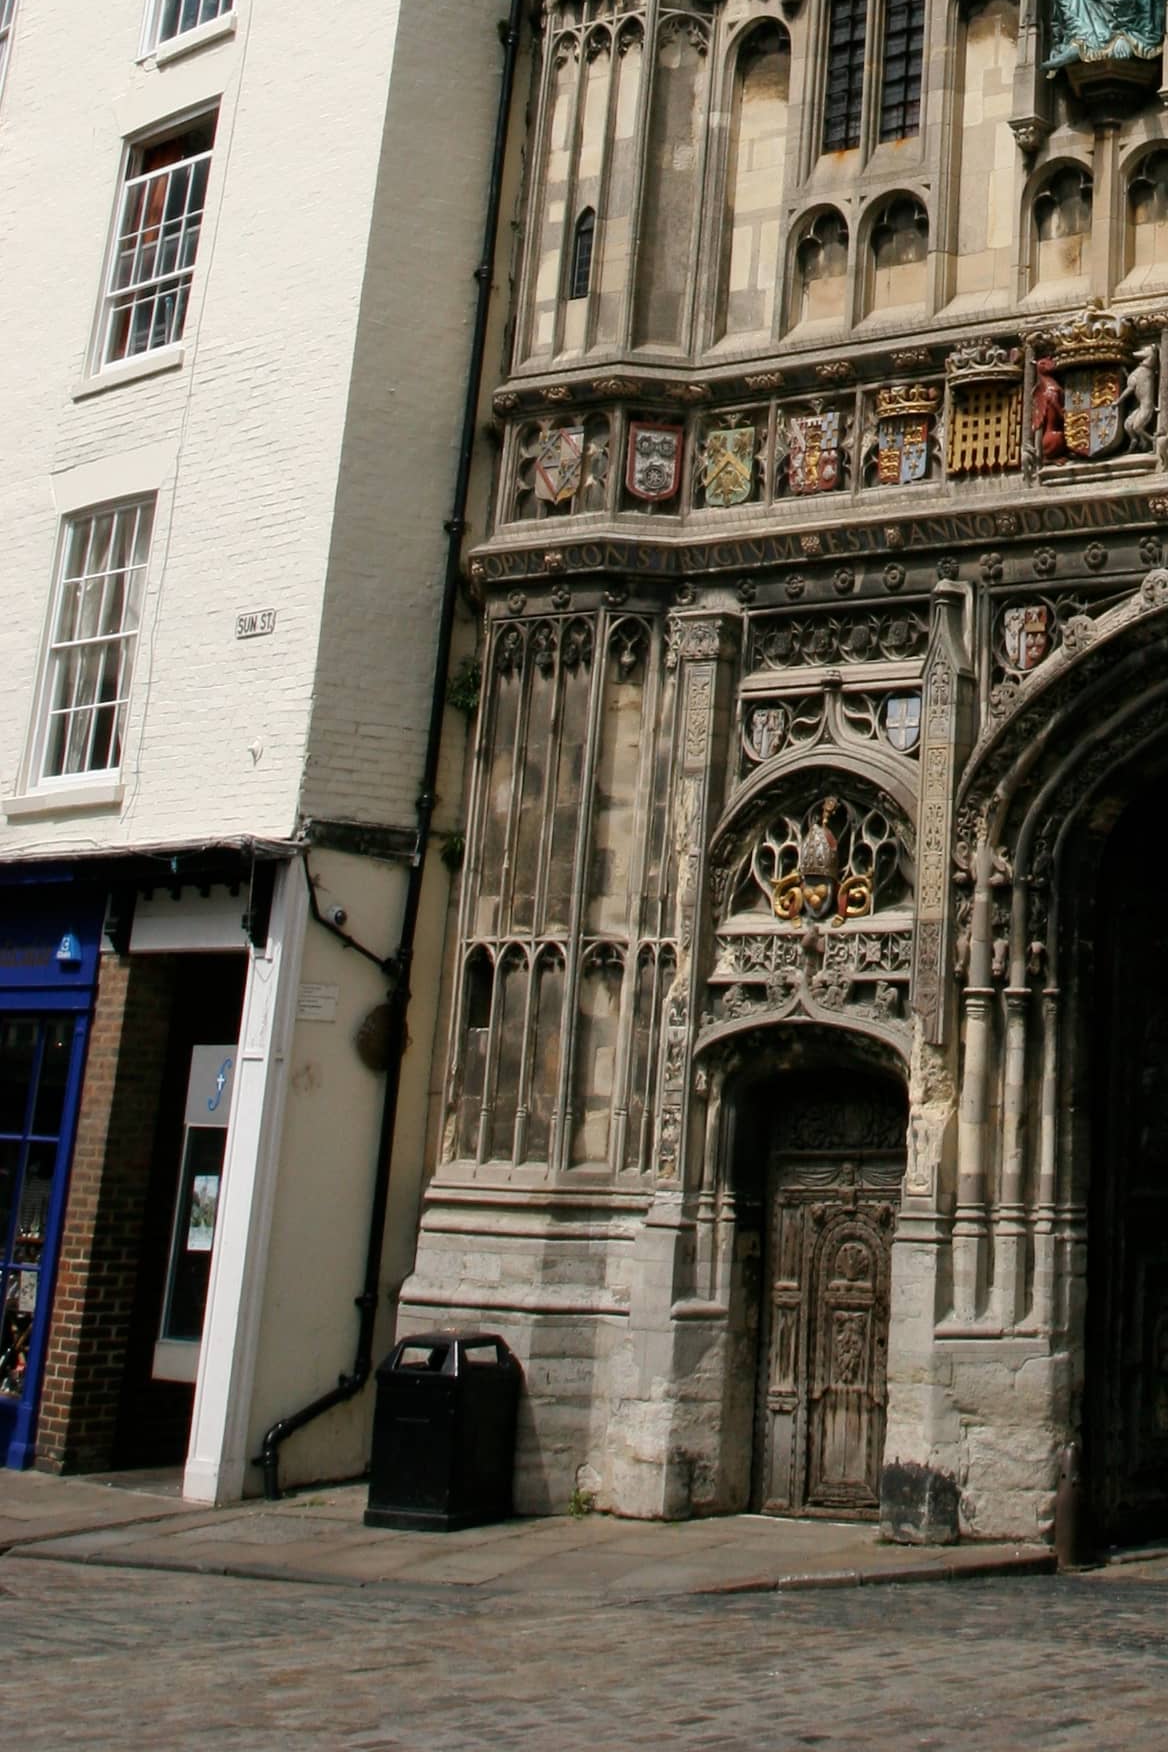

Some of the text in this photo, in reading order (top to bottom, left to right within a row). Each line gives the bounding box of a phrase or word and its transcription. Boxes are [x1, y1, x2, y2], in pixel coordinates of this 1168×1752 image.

[825, 527, 878, 554] EST
[909, 512, 997, 546] ANNO
[1019, 496, 1146, 535] DOMINI
[238, 615, 257, 634] SUN
